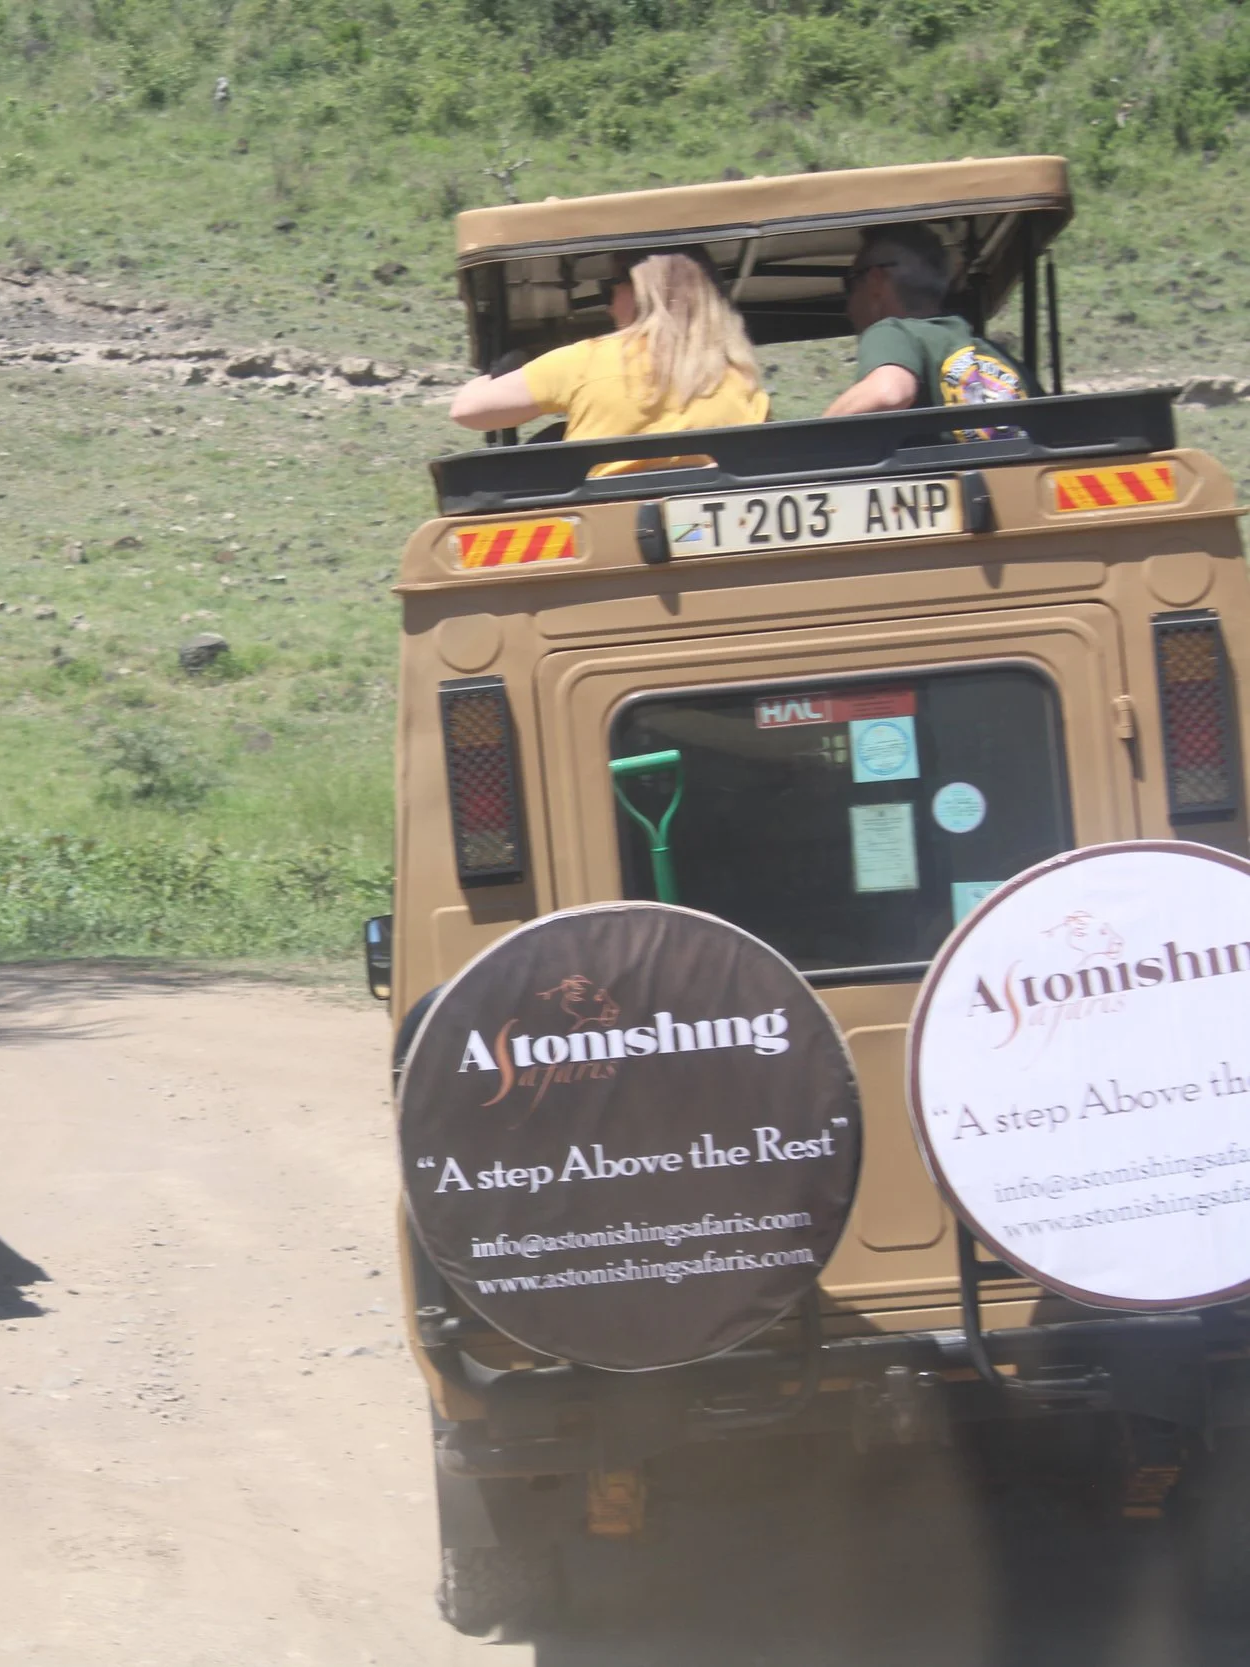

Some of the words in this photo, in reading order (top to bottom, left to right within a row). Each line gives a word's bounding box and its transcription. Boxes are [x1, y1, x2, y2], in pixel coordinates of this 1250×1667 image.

[702, 500, 725, 548] T
[746, 491, 830, 544] 203
[864, 482, 951, 533] ANP
[457, 1008, 790, 1075] Astonishing
[996, 1104, 1069, 1134] step
[1078, 1079, 1202, 1121] Above
[1210, 1061, 1250, 1097] th
[477, 1159, 553, 1193] step
[558, 1143, 683, 1182] Above
[688, 1134, 751, 1170] the
[471, 1211, 812, 1260] info@astonishingsafaris.com
[476, 1245, 815, 1295] www.astonishingsafaris.com
